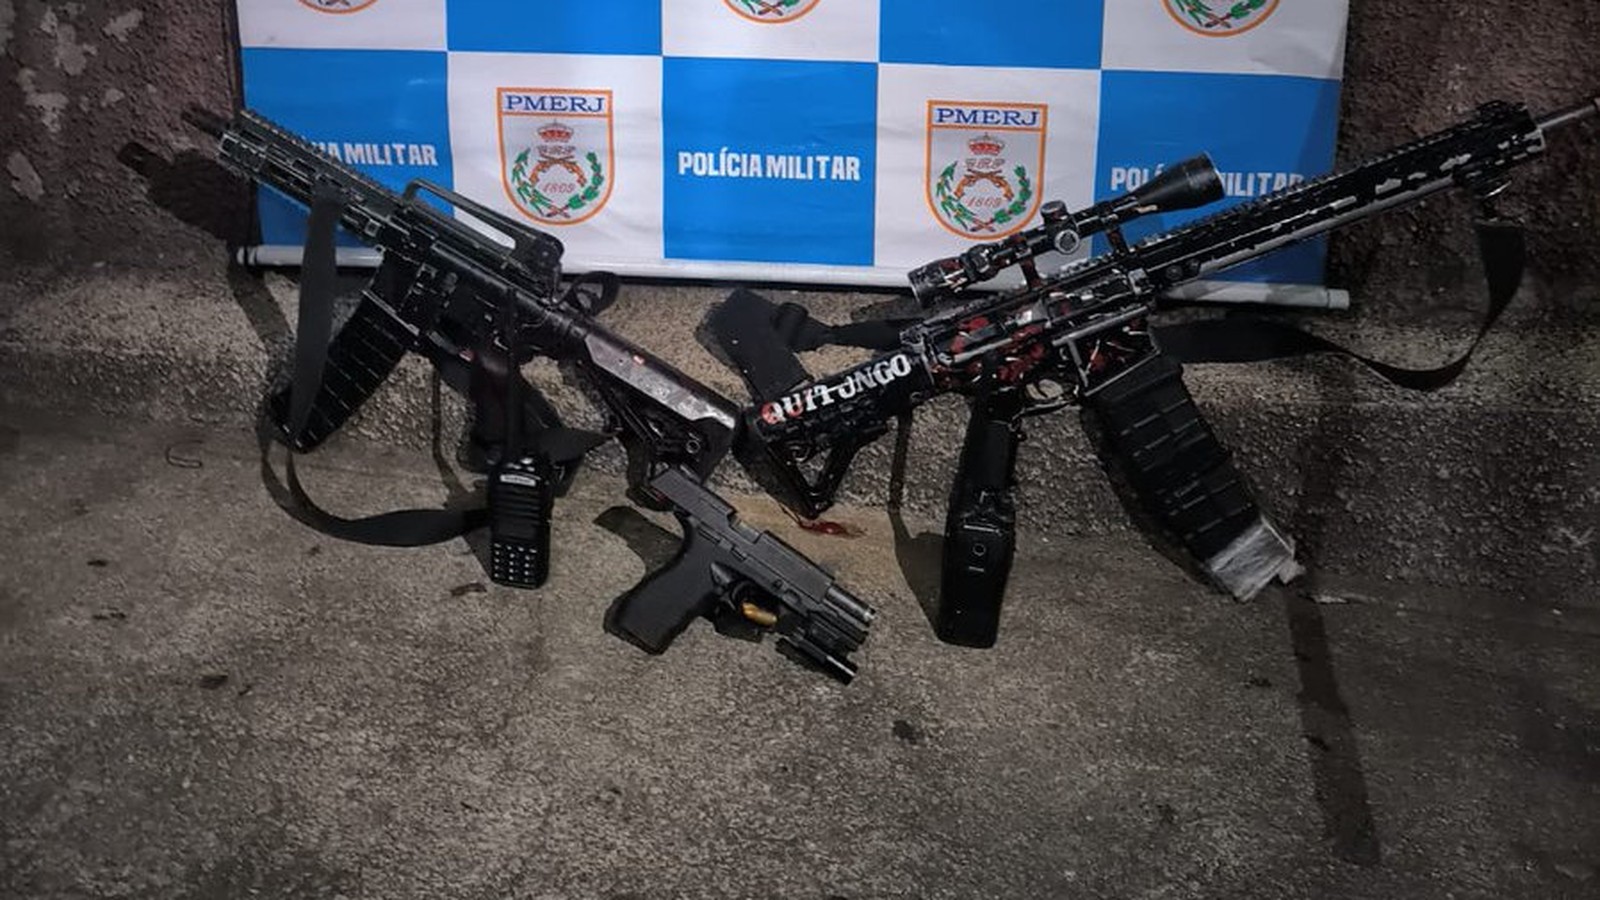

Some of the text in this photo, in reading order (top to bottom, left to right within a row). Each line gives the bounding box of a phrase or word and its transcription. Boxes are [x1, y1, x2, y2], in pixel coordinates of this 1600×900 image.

[506, 94, 604, 112] PMERJ
[936, 108, 1039, 125] PMERJ
[343, 142, 438, 166] MILITAR
[678, 146, 861, 181] POLÍCIA MILITAR
